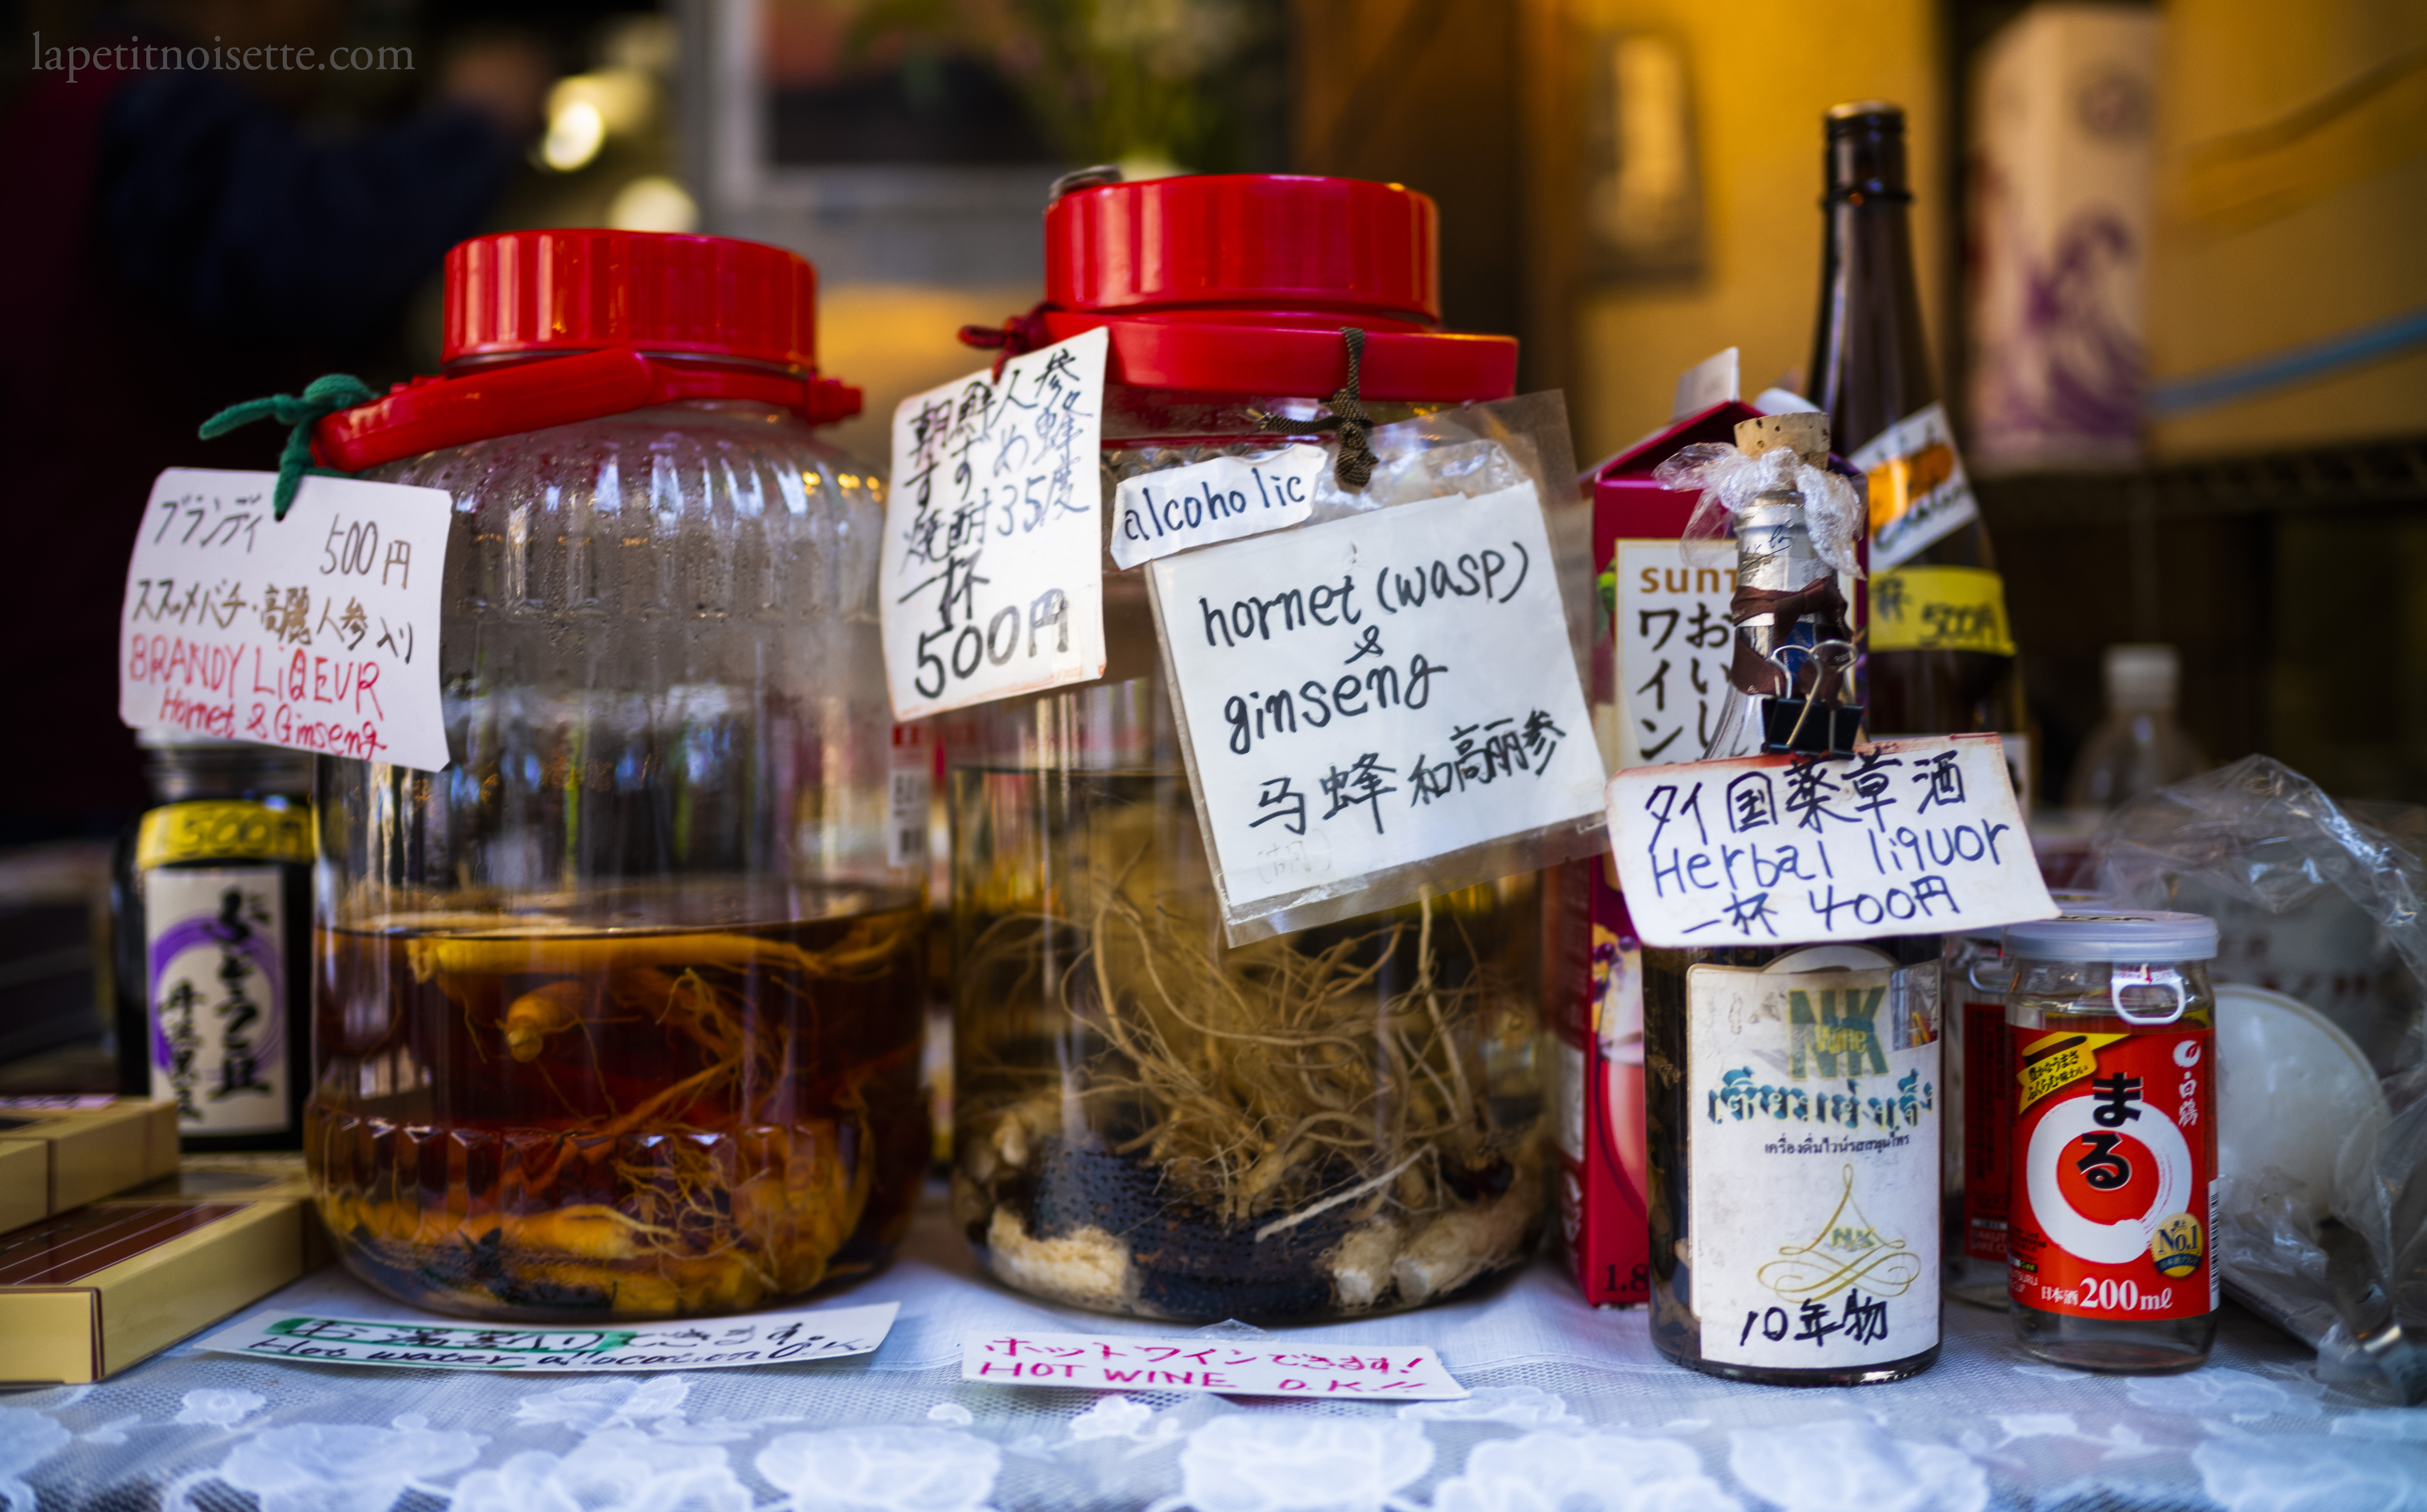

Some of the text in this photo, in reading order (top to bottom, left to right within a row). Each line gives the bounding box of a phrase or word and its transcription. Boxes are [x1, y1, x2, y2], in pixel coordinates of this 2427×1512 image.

[1123, 467, 1307, 542] alcoholic
[320, 513, 412, 590] 500円
[1199, 541, 1530, 647] hornet (wasp)
[129, 633, 246, 699] BRANDY
[914, 588, 1069, 699] 500円
[1344, 624, 1385, 665] &
[1224, 653, 1448, 755] ginseng
[1636, 608, 1684, 765] ワイン
[1686, 601, 1732, 763] おいし
[159, 687, 388, 761] Hornet & Ginseng
[1645, 749, 1965, 854] タイ国薬草酒
[1652, 842, 1833, 898] Herbal
[1681, 874, 1961, 937] 一杯 400円
[1788, 985, 1890, 1080] NK
[2076, 1071, 2143, 1192] まる
[1739, 1288, 1887, 1347] 10年物
[2041, 1285, 2078, 1306] 日本酒
[979, 1362, 1087, 1378] HOT
[1102, 1367, 1239, 1388] WINE
